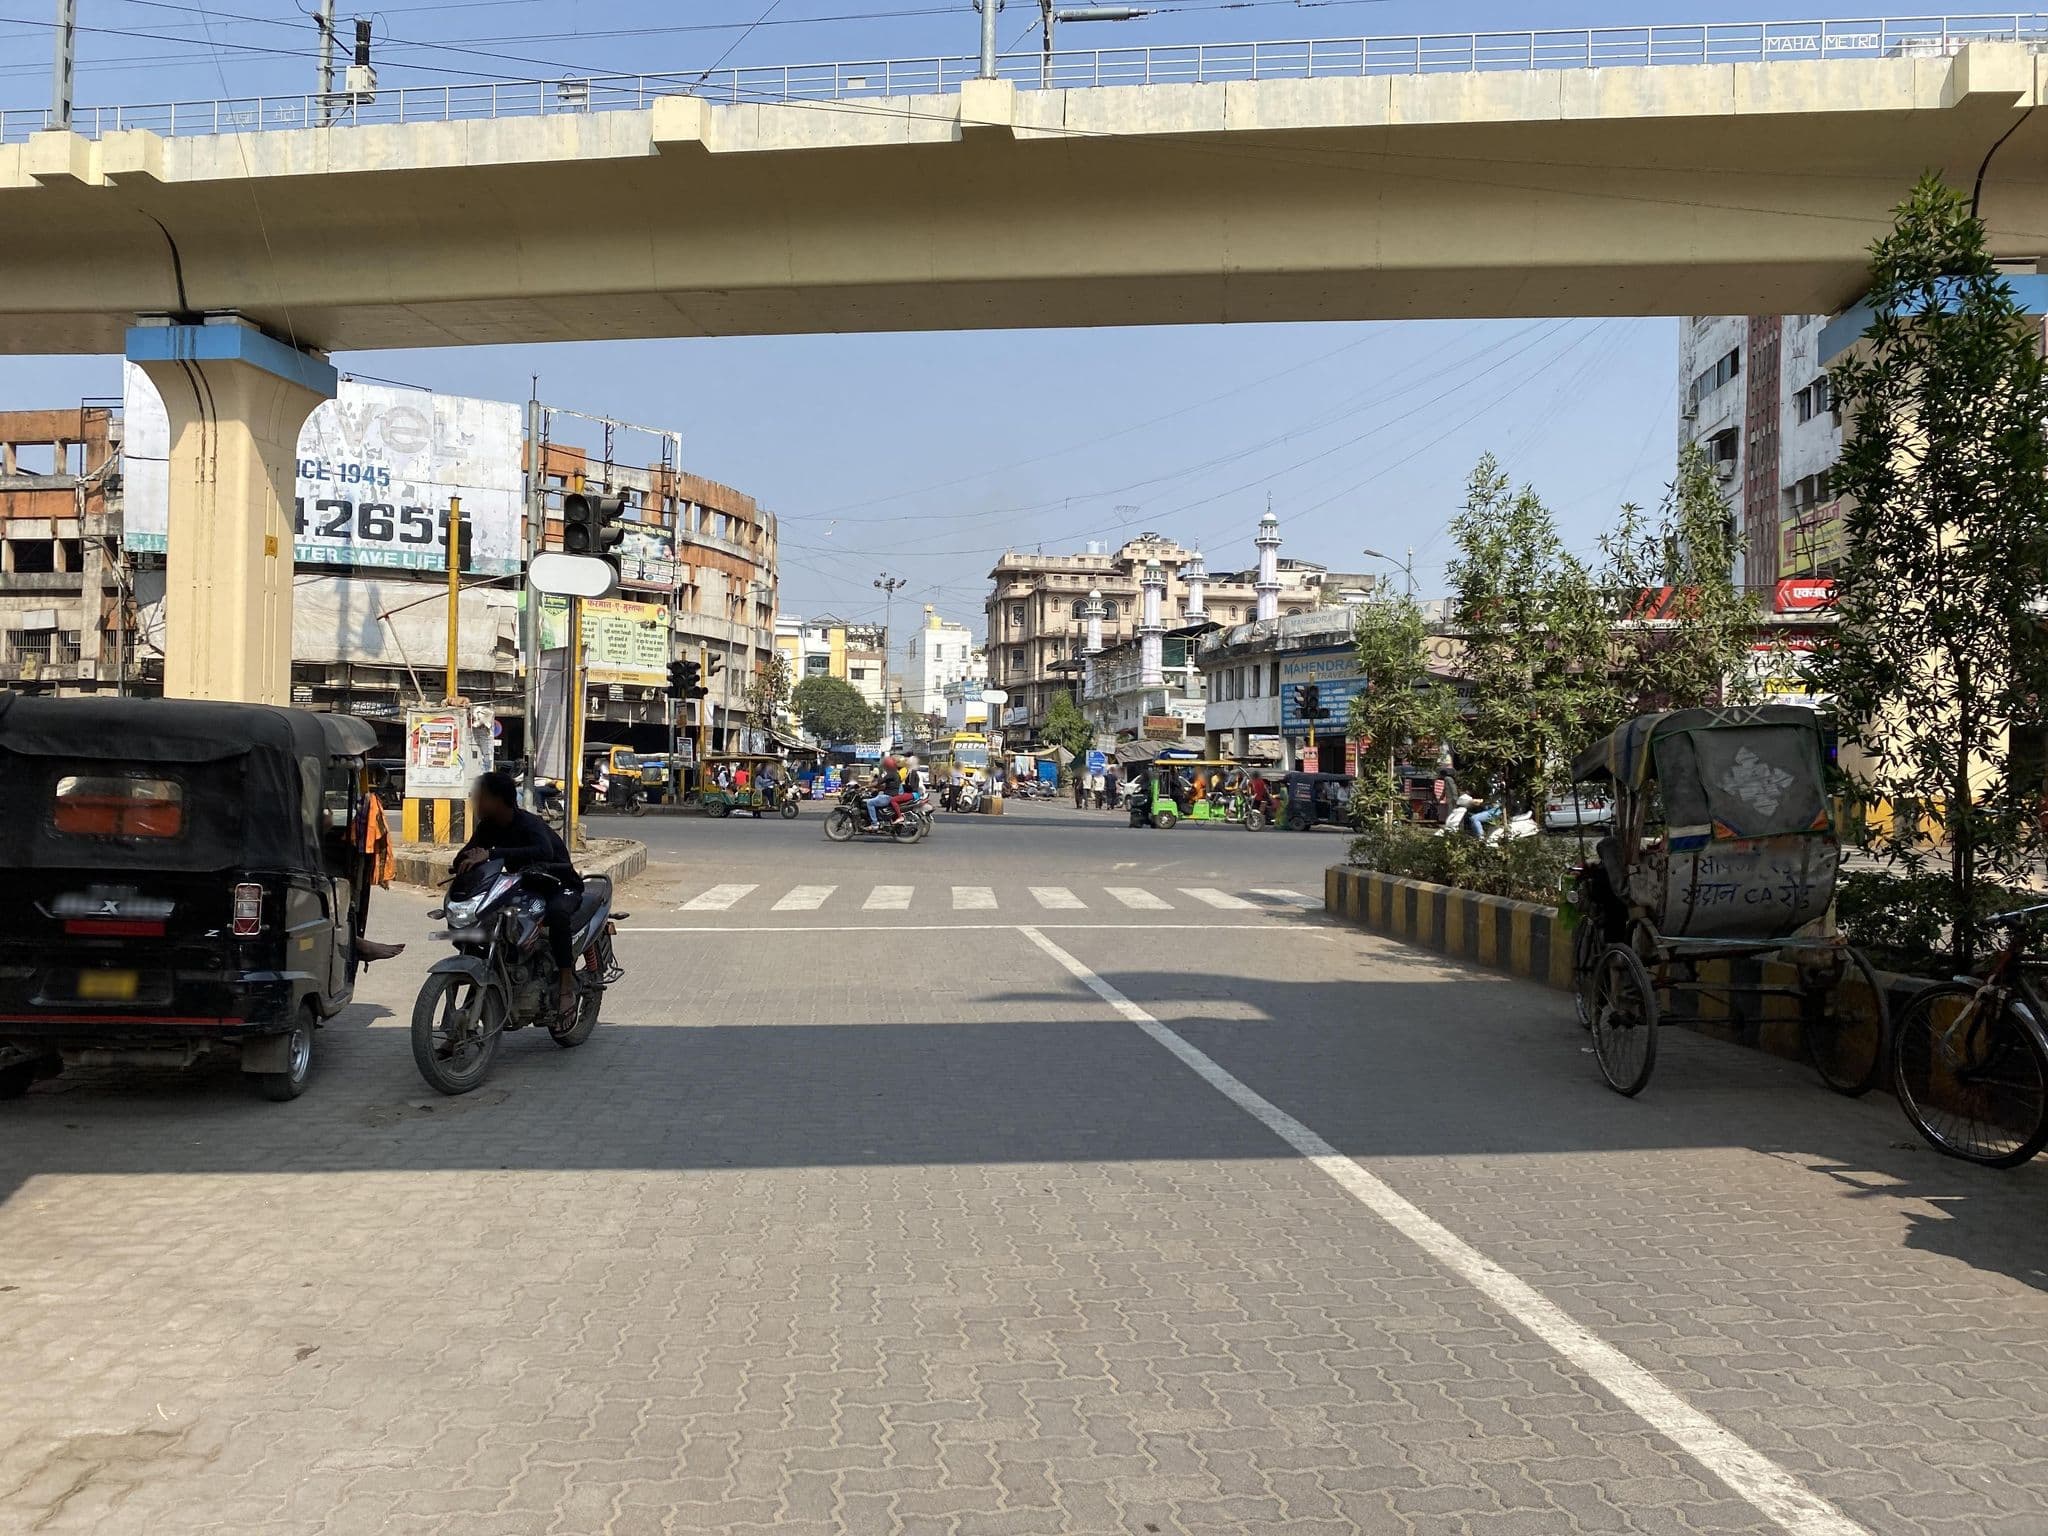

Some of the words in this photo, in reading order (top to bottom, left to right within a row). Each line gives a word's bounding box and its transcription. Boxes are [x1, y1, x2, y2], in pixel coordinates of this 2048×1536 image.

[1767, 37, 1817, 50] MAHA
[1825, 35, 1880, 48] METRO
[337, 463, 391, 487] 1945
[295, 546, 338, 562] TER
[343, 550, 399, 566] SAVE
[1744, 887, 1772, 904] CA
